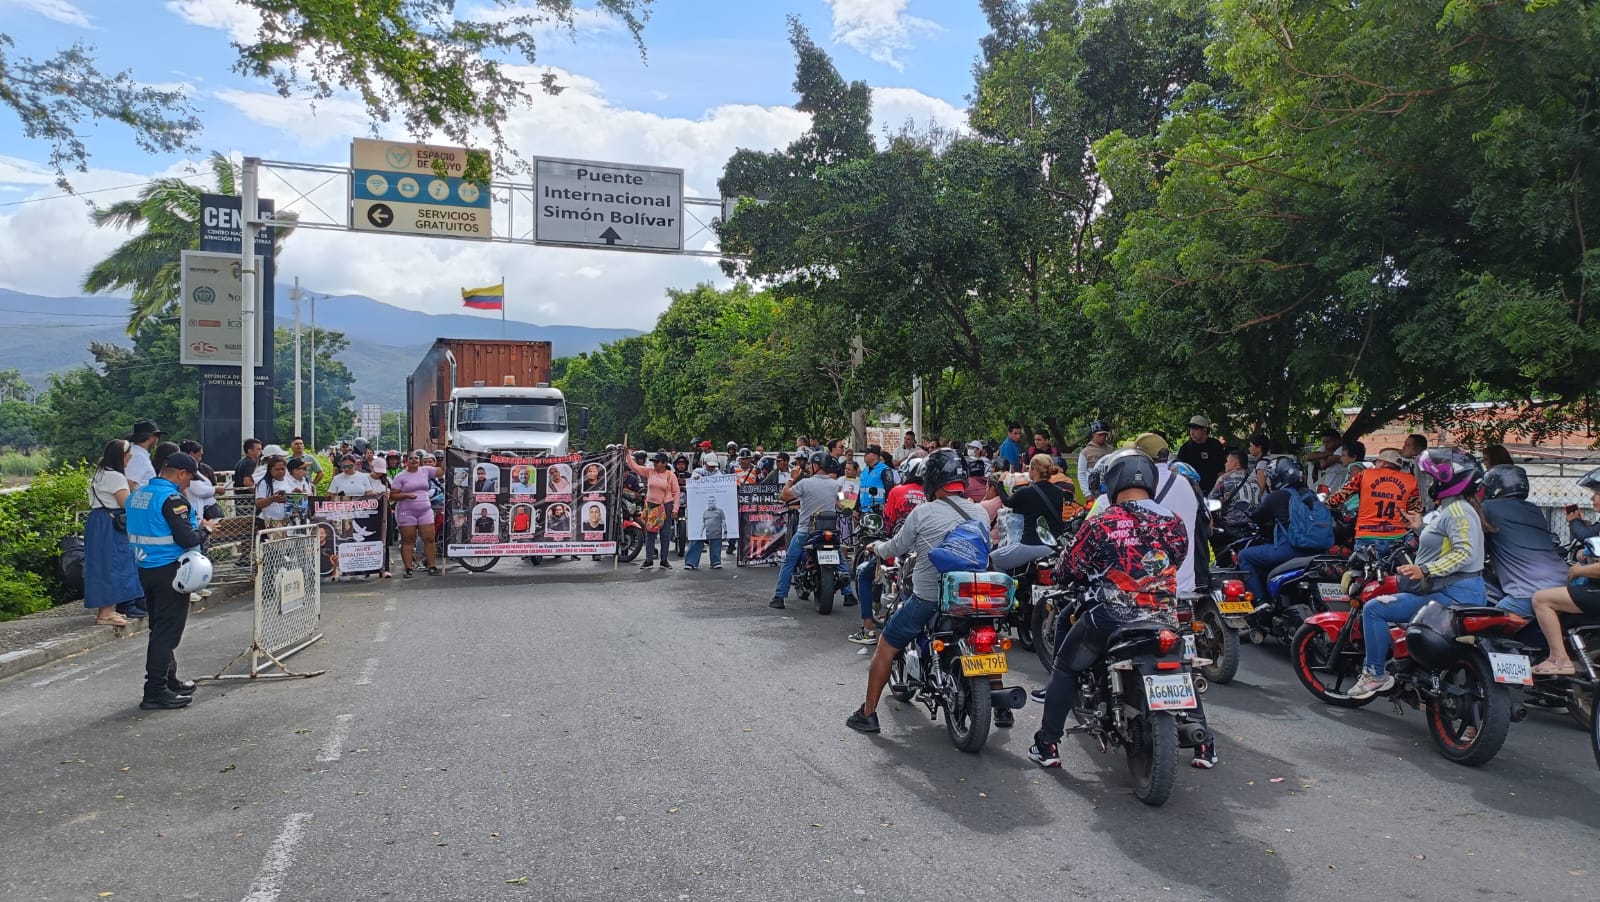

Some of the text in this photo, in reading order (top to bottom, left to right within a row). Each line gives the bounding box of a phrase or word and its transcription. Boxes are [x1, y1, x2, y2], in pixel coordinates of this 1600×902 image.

[417, 150, 455, 161] ESPACIO
[417, 160, 430, 169] DE
[577, 168, 643, 186] Puente
[545, 185, 671, 208] Internacional
[204, 206, 272, 231] CENF
[418, 209, 477, 221] SERVICIOS
[543, 205, 675, 228] Simón Bolívar
[415, 220, 480, 233] GRATUITOS
[1370, 476, 1408, 495] DOMICILIOS
[1371, 491, 1395, 500] MARCE
[315, 499, 378, 512] LIBERTAD
[1375, 500, 1396, 519] 14
[1107, 529, 1130, 540] MOTOS
